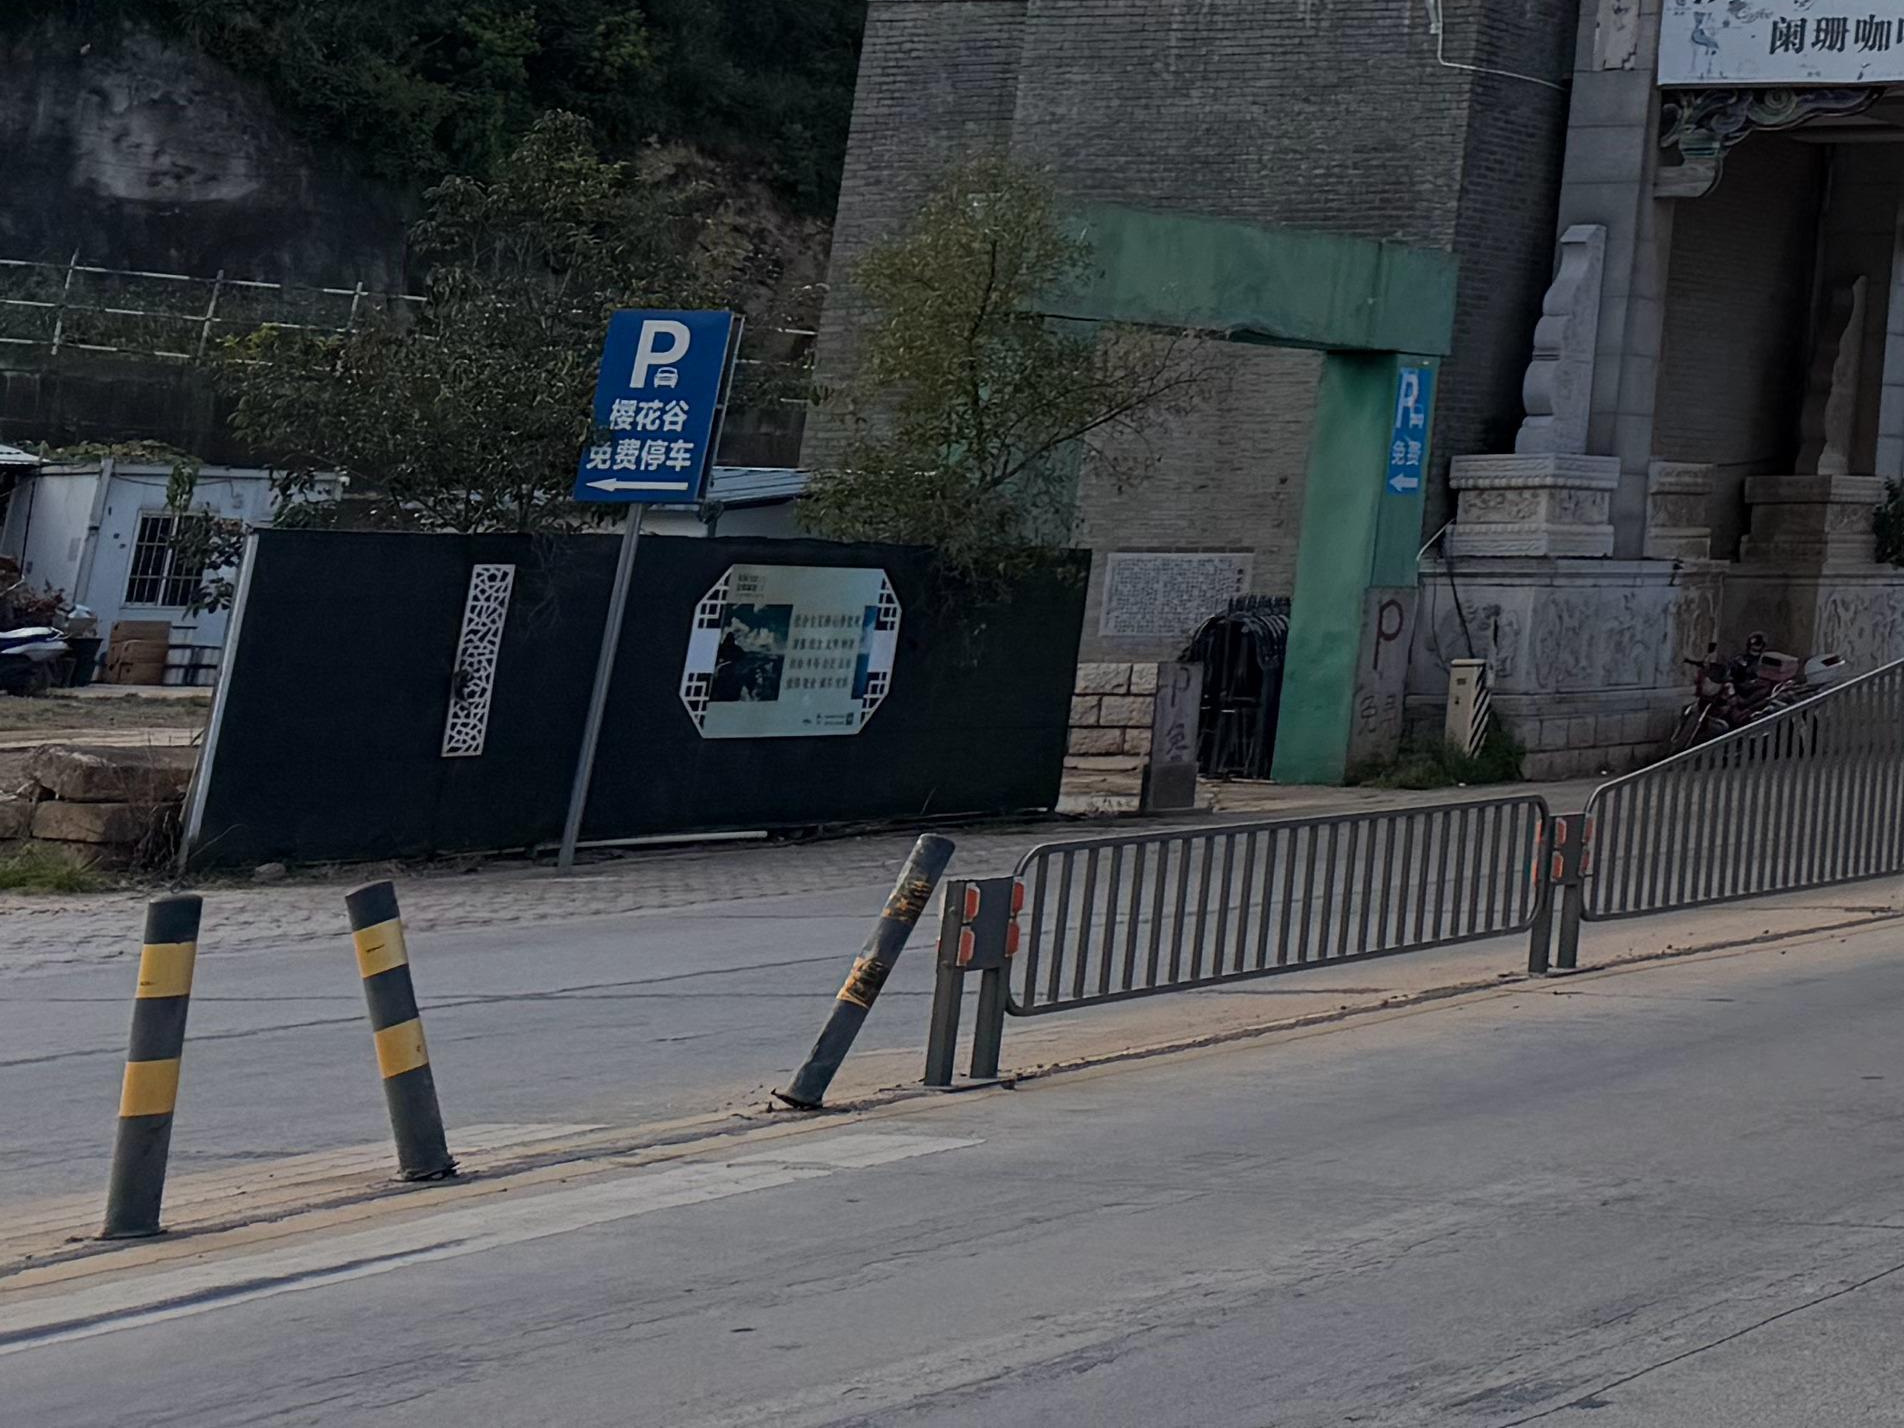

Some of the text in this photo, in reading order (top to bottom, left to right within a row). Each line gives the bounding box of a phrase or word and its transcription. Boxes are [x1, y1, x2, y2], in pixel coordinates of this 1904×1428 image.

[629, 319, 691, 389] P
[609, 398, 690, 432] 樱花谷
[1395, 372, 1420, 429] P
[585, 439, 695, 472] 免费停车
